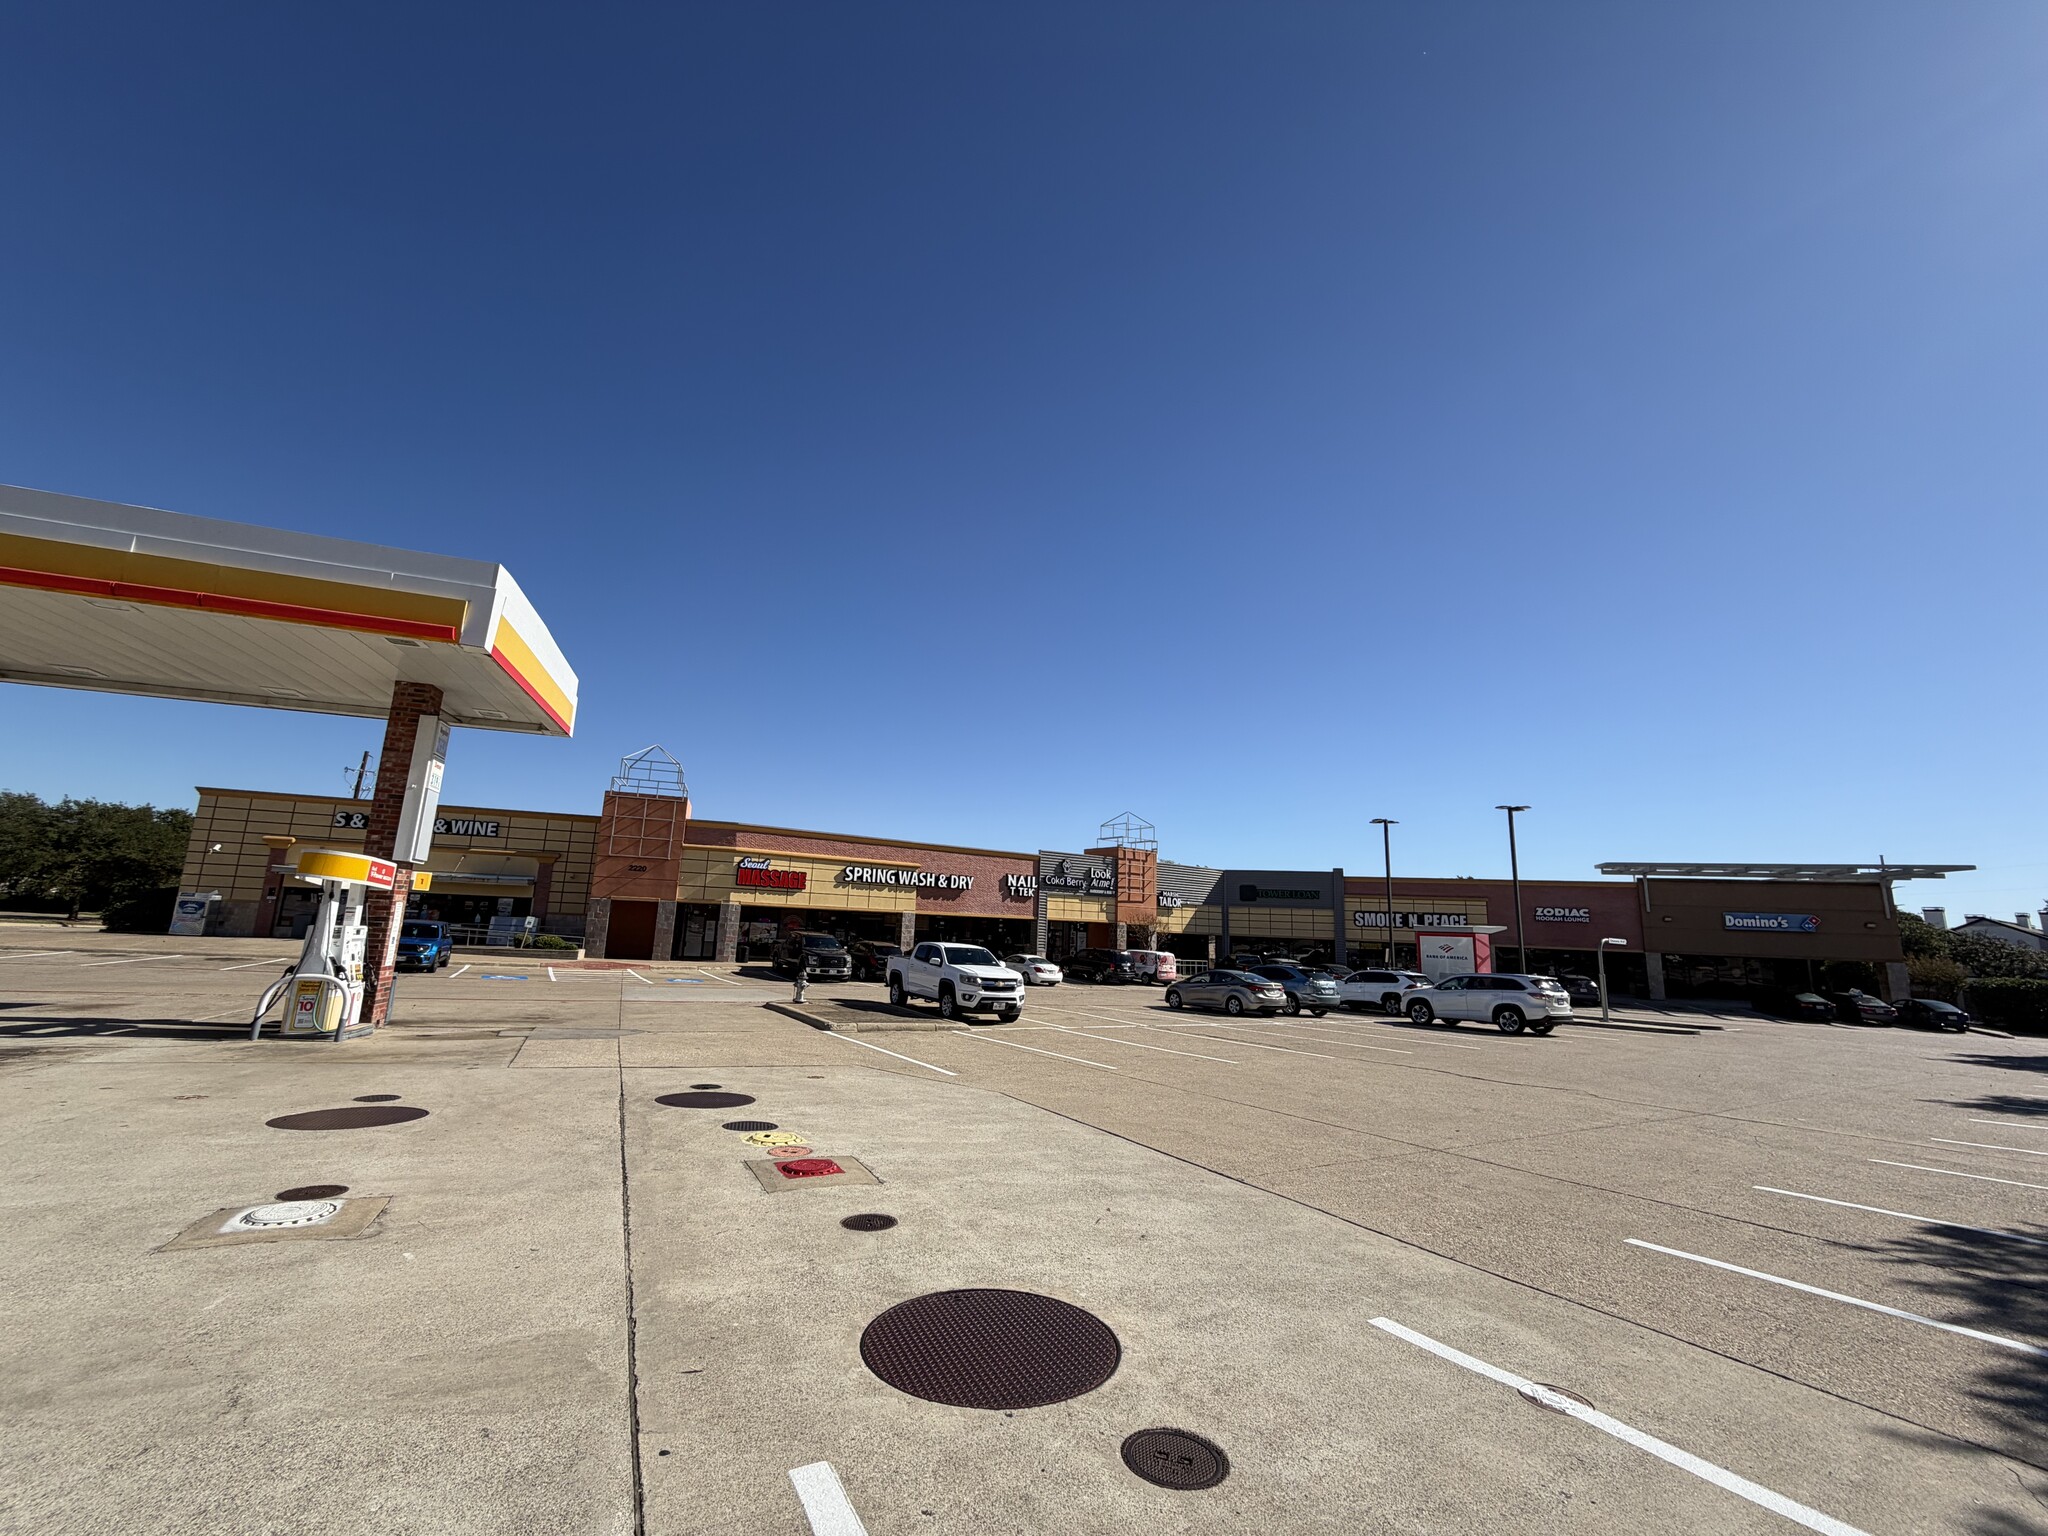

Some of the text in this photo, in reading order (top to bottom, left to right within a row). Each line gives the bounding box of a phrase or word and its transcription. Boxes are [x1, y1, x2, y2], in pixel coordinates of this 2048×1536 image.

[334, 812, 498, 836] S & & WINE
[740, 857, 770, 870] Seoul
[737, 868, 807, 890] MASSAGE
[845, 866, 974, 890] SPRING WASH & DRY
[1091, 867, 1111, 879] Look
[1008, 874, 1038, 888] NAIL
[1046, 875, 1086, 889] Coko Berry
[1010, 886, 1036, 897] T TEK
[1258, 890, 1320, 898] TOWER LOAN
[1158, 896, 1182, 908] TAILOR
[1536, 908, 1590, 916] ZODIAC
[1354, 912, 1466, 928] SMOKE N PEACE
[1725, 914, 1788, 928] Domino's
